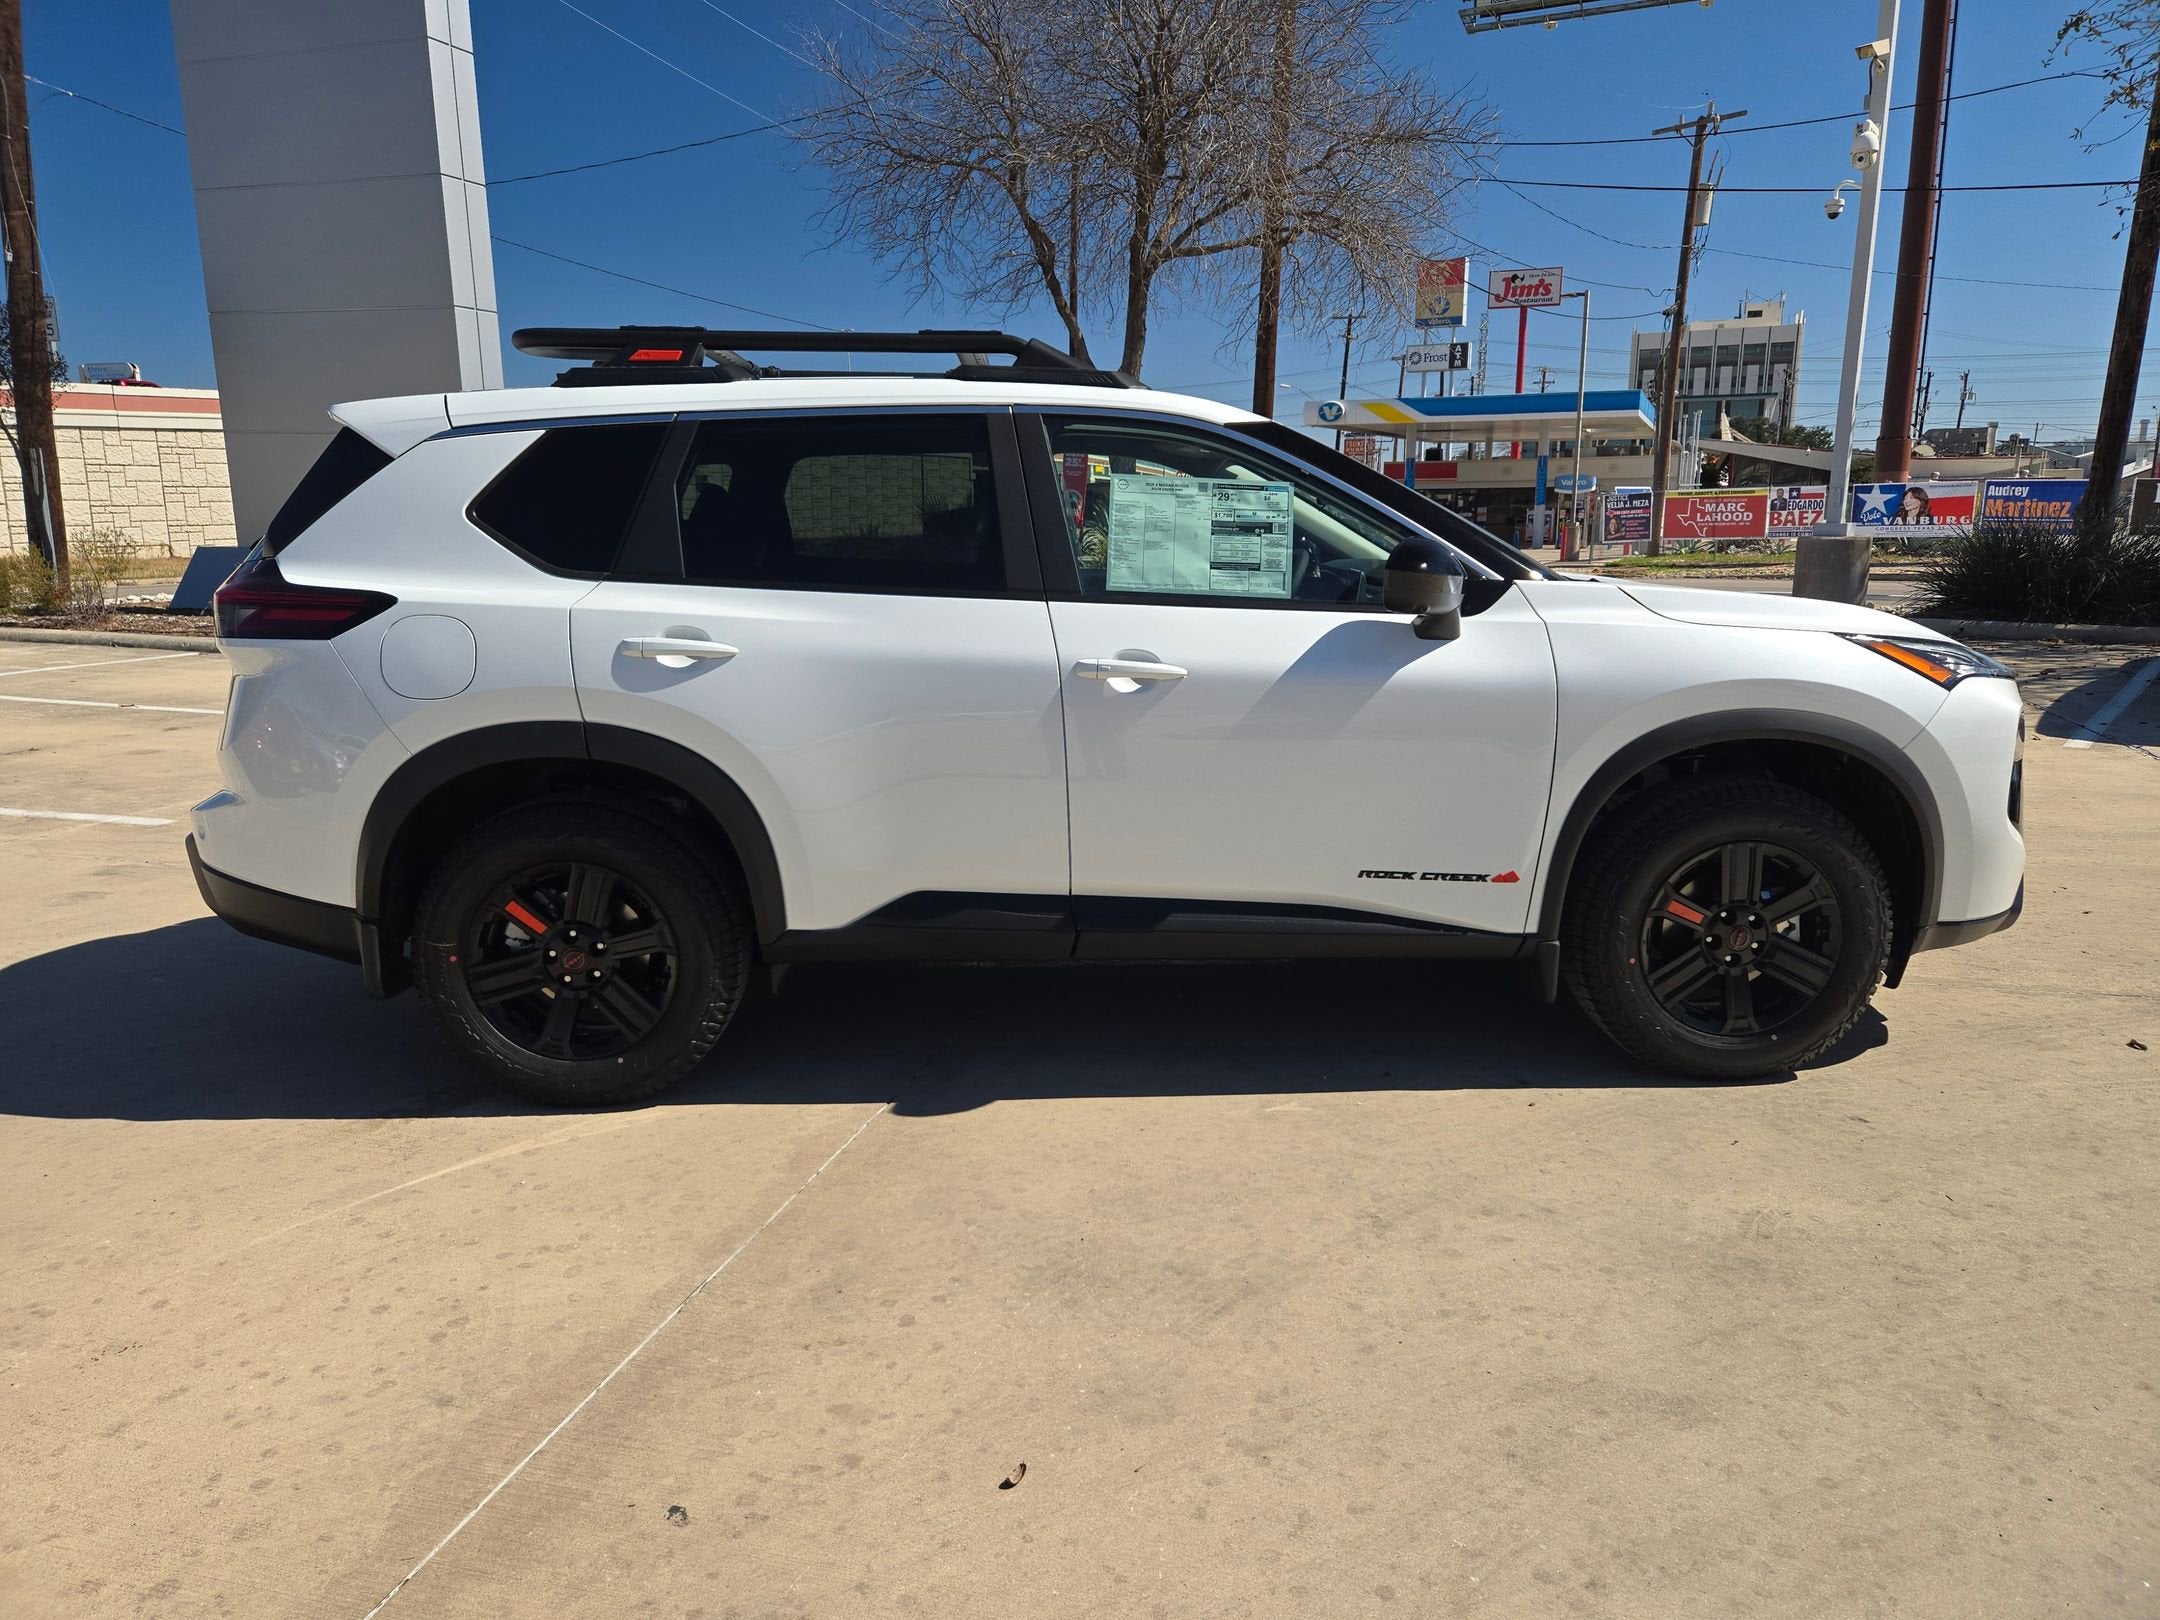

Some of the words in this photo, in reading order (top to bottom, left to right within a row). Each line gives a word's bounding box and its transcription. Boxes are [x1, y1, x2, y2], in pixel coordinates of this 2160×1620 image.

[1494, 277, 1553, 303] Jim's
[47, 324, 54, 336] 5
[1423, 352, 1447, 363] Frost
[1454, 345, 1462, 367] ATM
[1218, 493, 1230, 501] 29
[1988, 486, 2029, 497] Audrey
[1705, 503, 1746, 512] MARC
[1788, 500, 1824, 510] EDGARDO
[1984, 498, 2072, 518] Martinez
[1861, 511, 1881, 521] Vote
[1357, 870, 1417, 880] ROCK
[1419, 872, 1491, 882] CREEK
